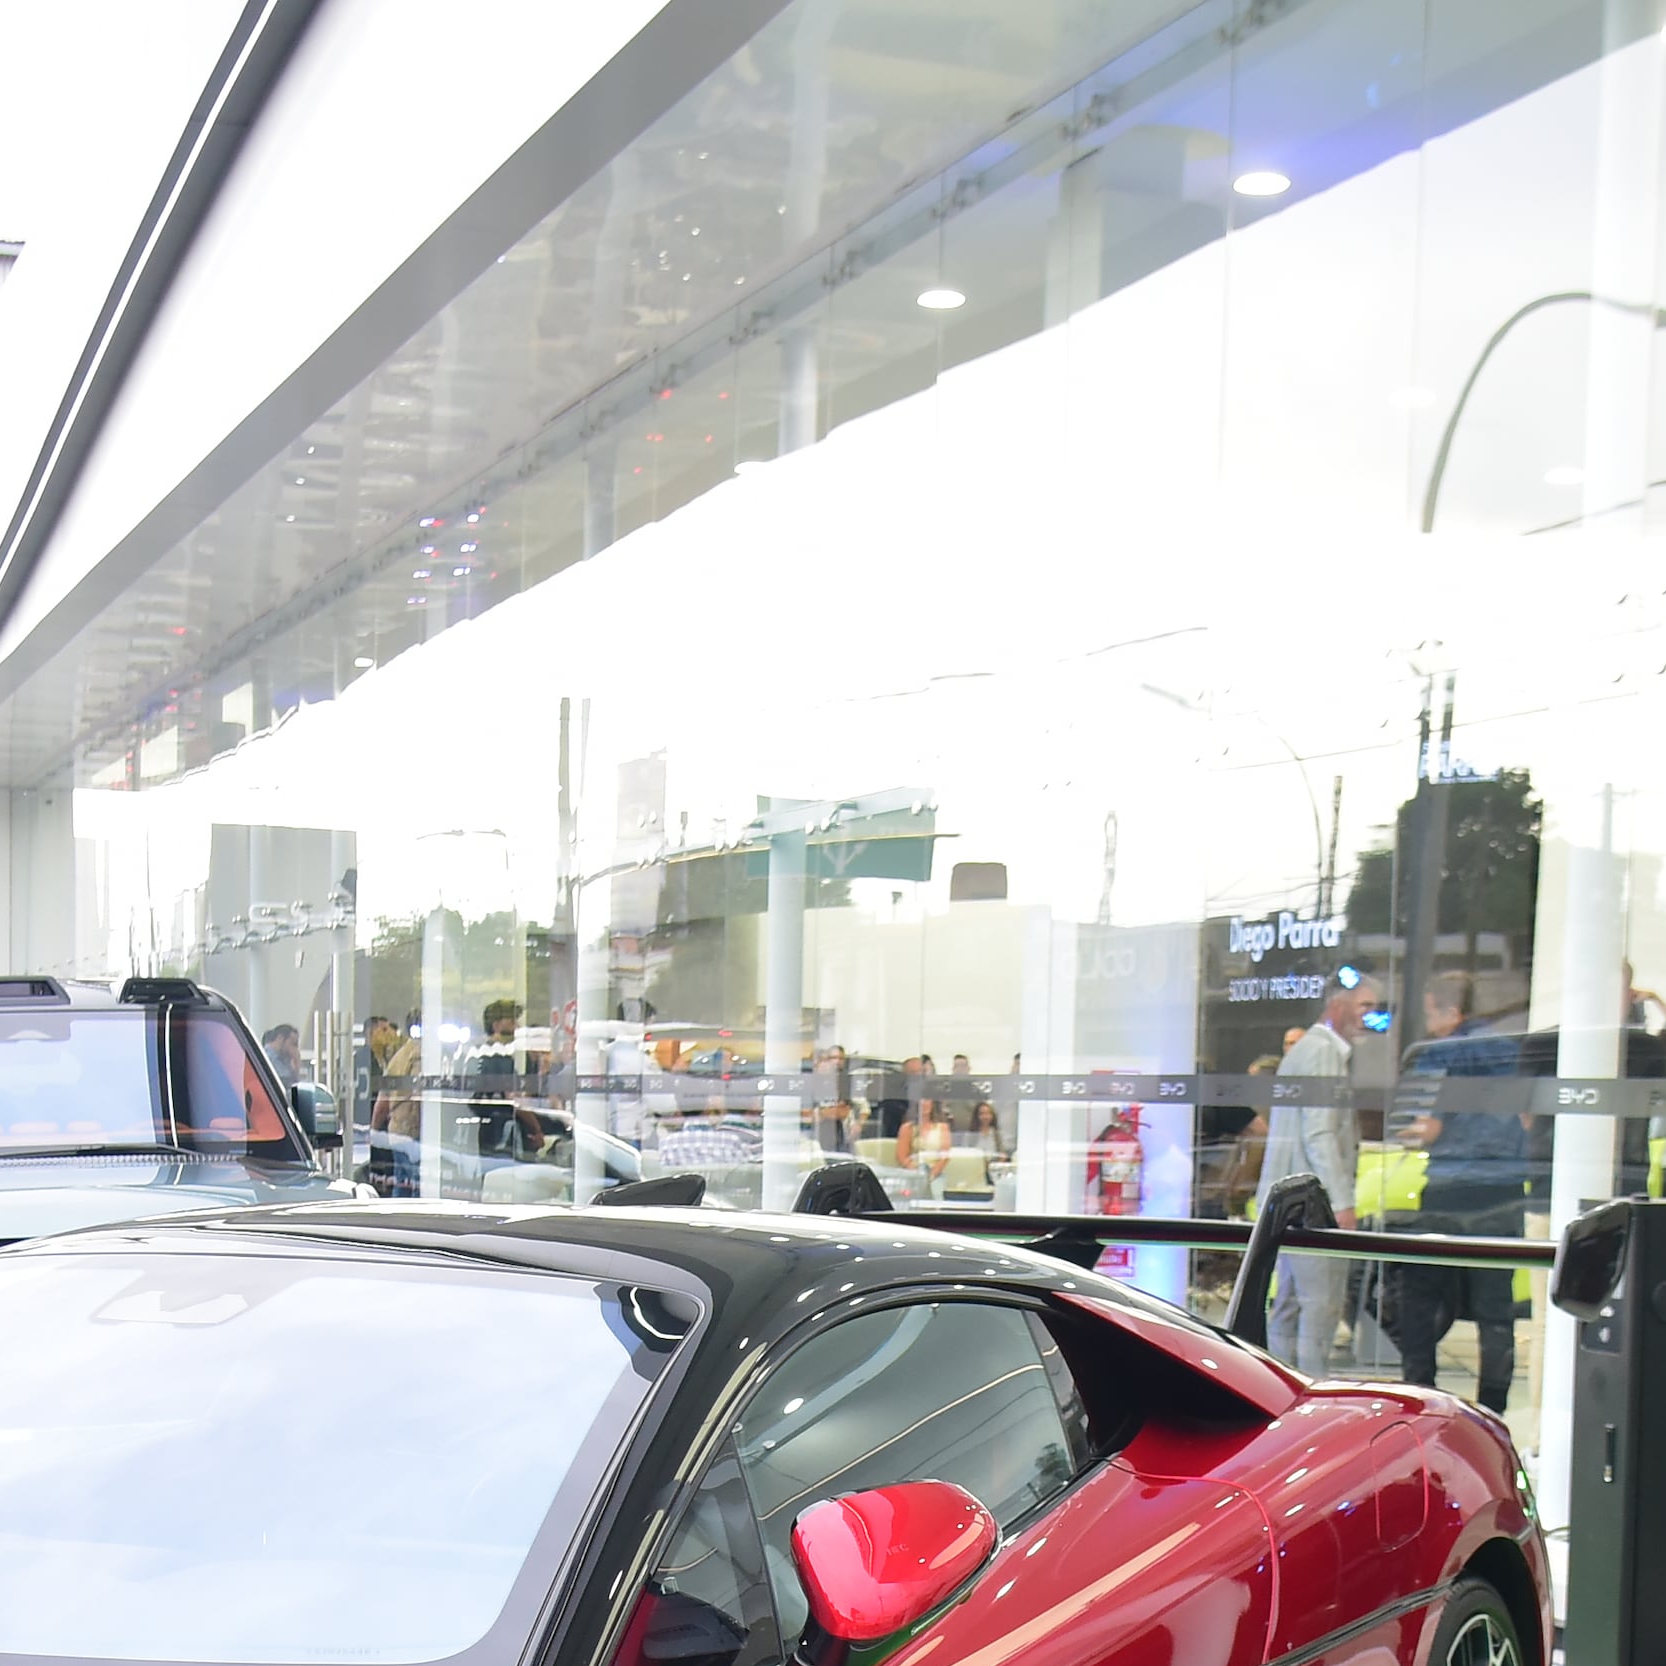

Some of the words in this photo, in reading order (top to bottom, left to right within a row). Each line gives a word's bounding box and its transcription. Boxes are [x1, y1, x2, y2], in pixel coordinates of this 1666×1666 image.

[1229, 917, 1276, 963] Diego
[1277, 910, 1341, 950] Parra
[1158, 1082, 1187, 1096] BYD
[1557, 1087, 1600, 1105] BYD
